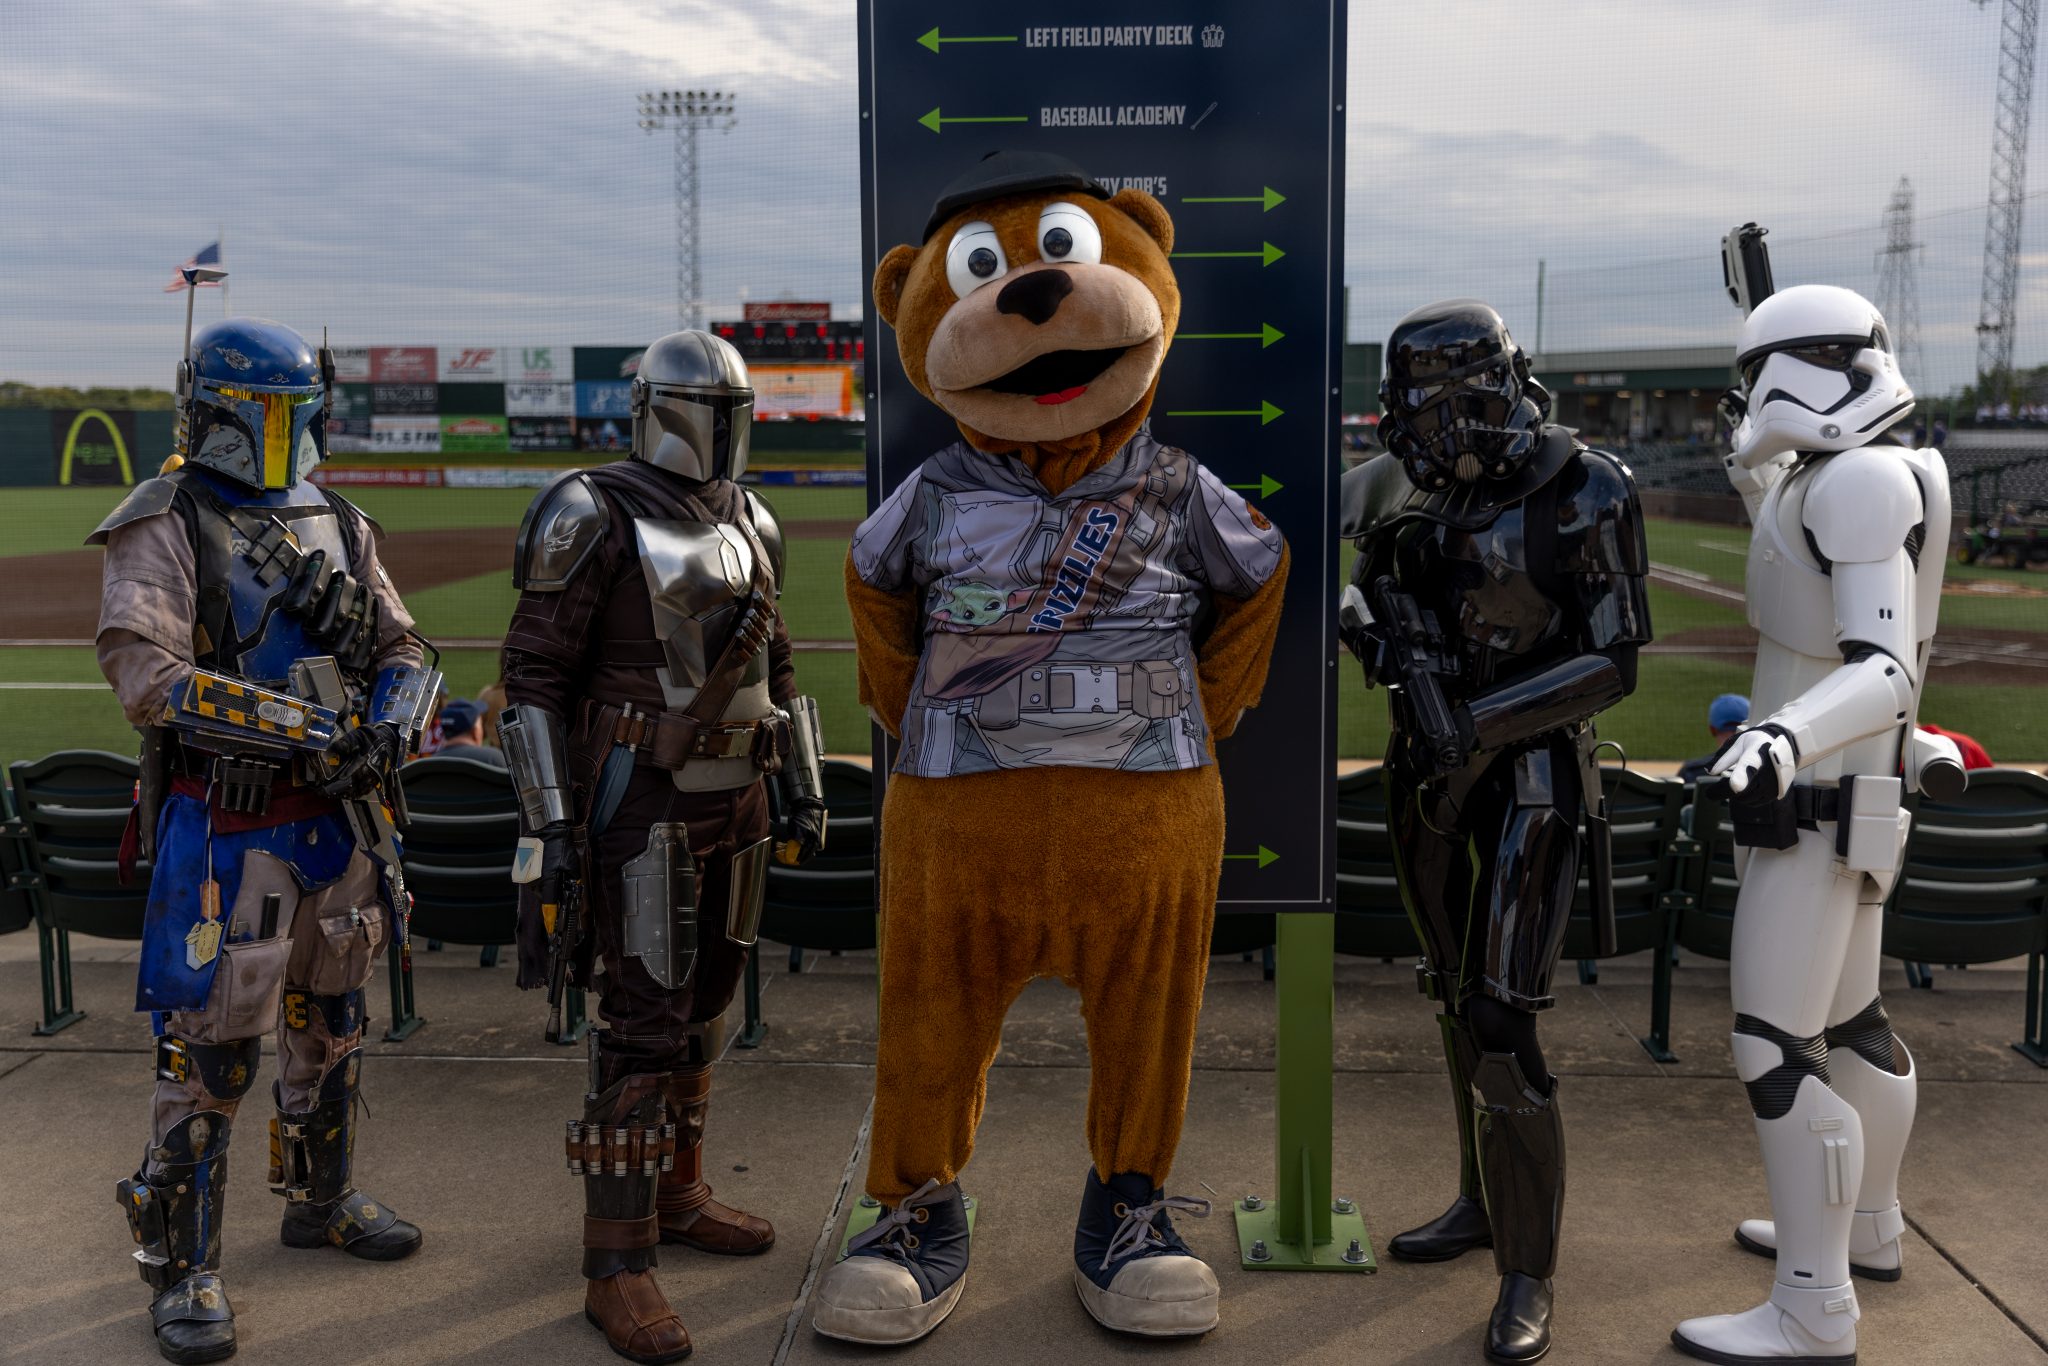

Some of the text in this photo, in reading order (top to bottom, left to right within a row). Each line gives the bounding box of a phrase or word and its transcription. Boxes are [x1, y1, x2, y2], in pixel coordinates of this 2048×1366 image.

[1025, 26, 1193, 48] LEFT FIELD PARTY DECK
[1040, 106, 1186, 127] BASEBALL ACADEMY
